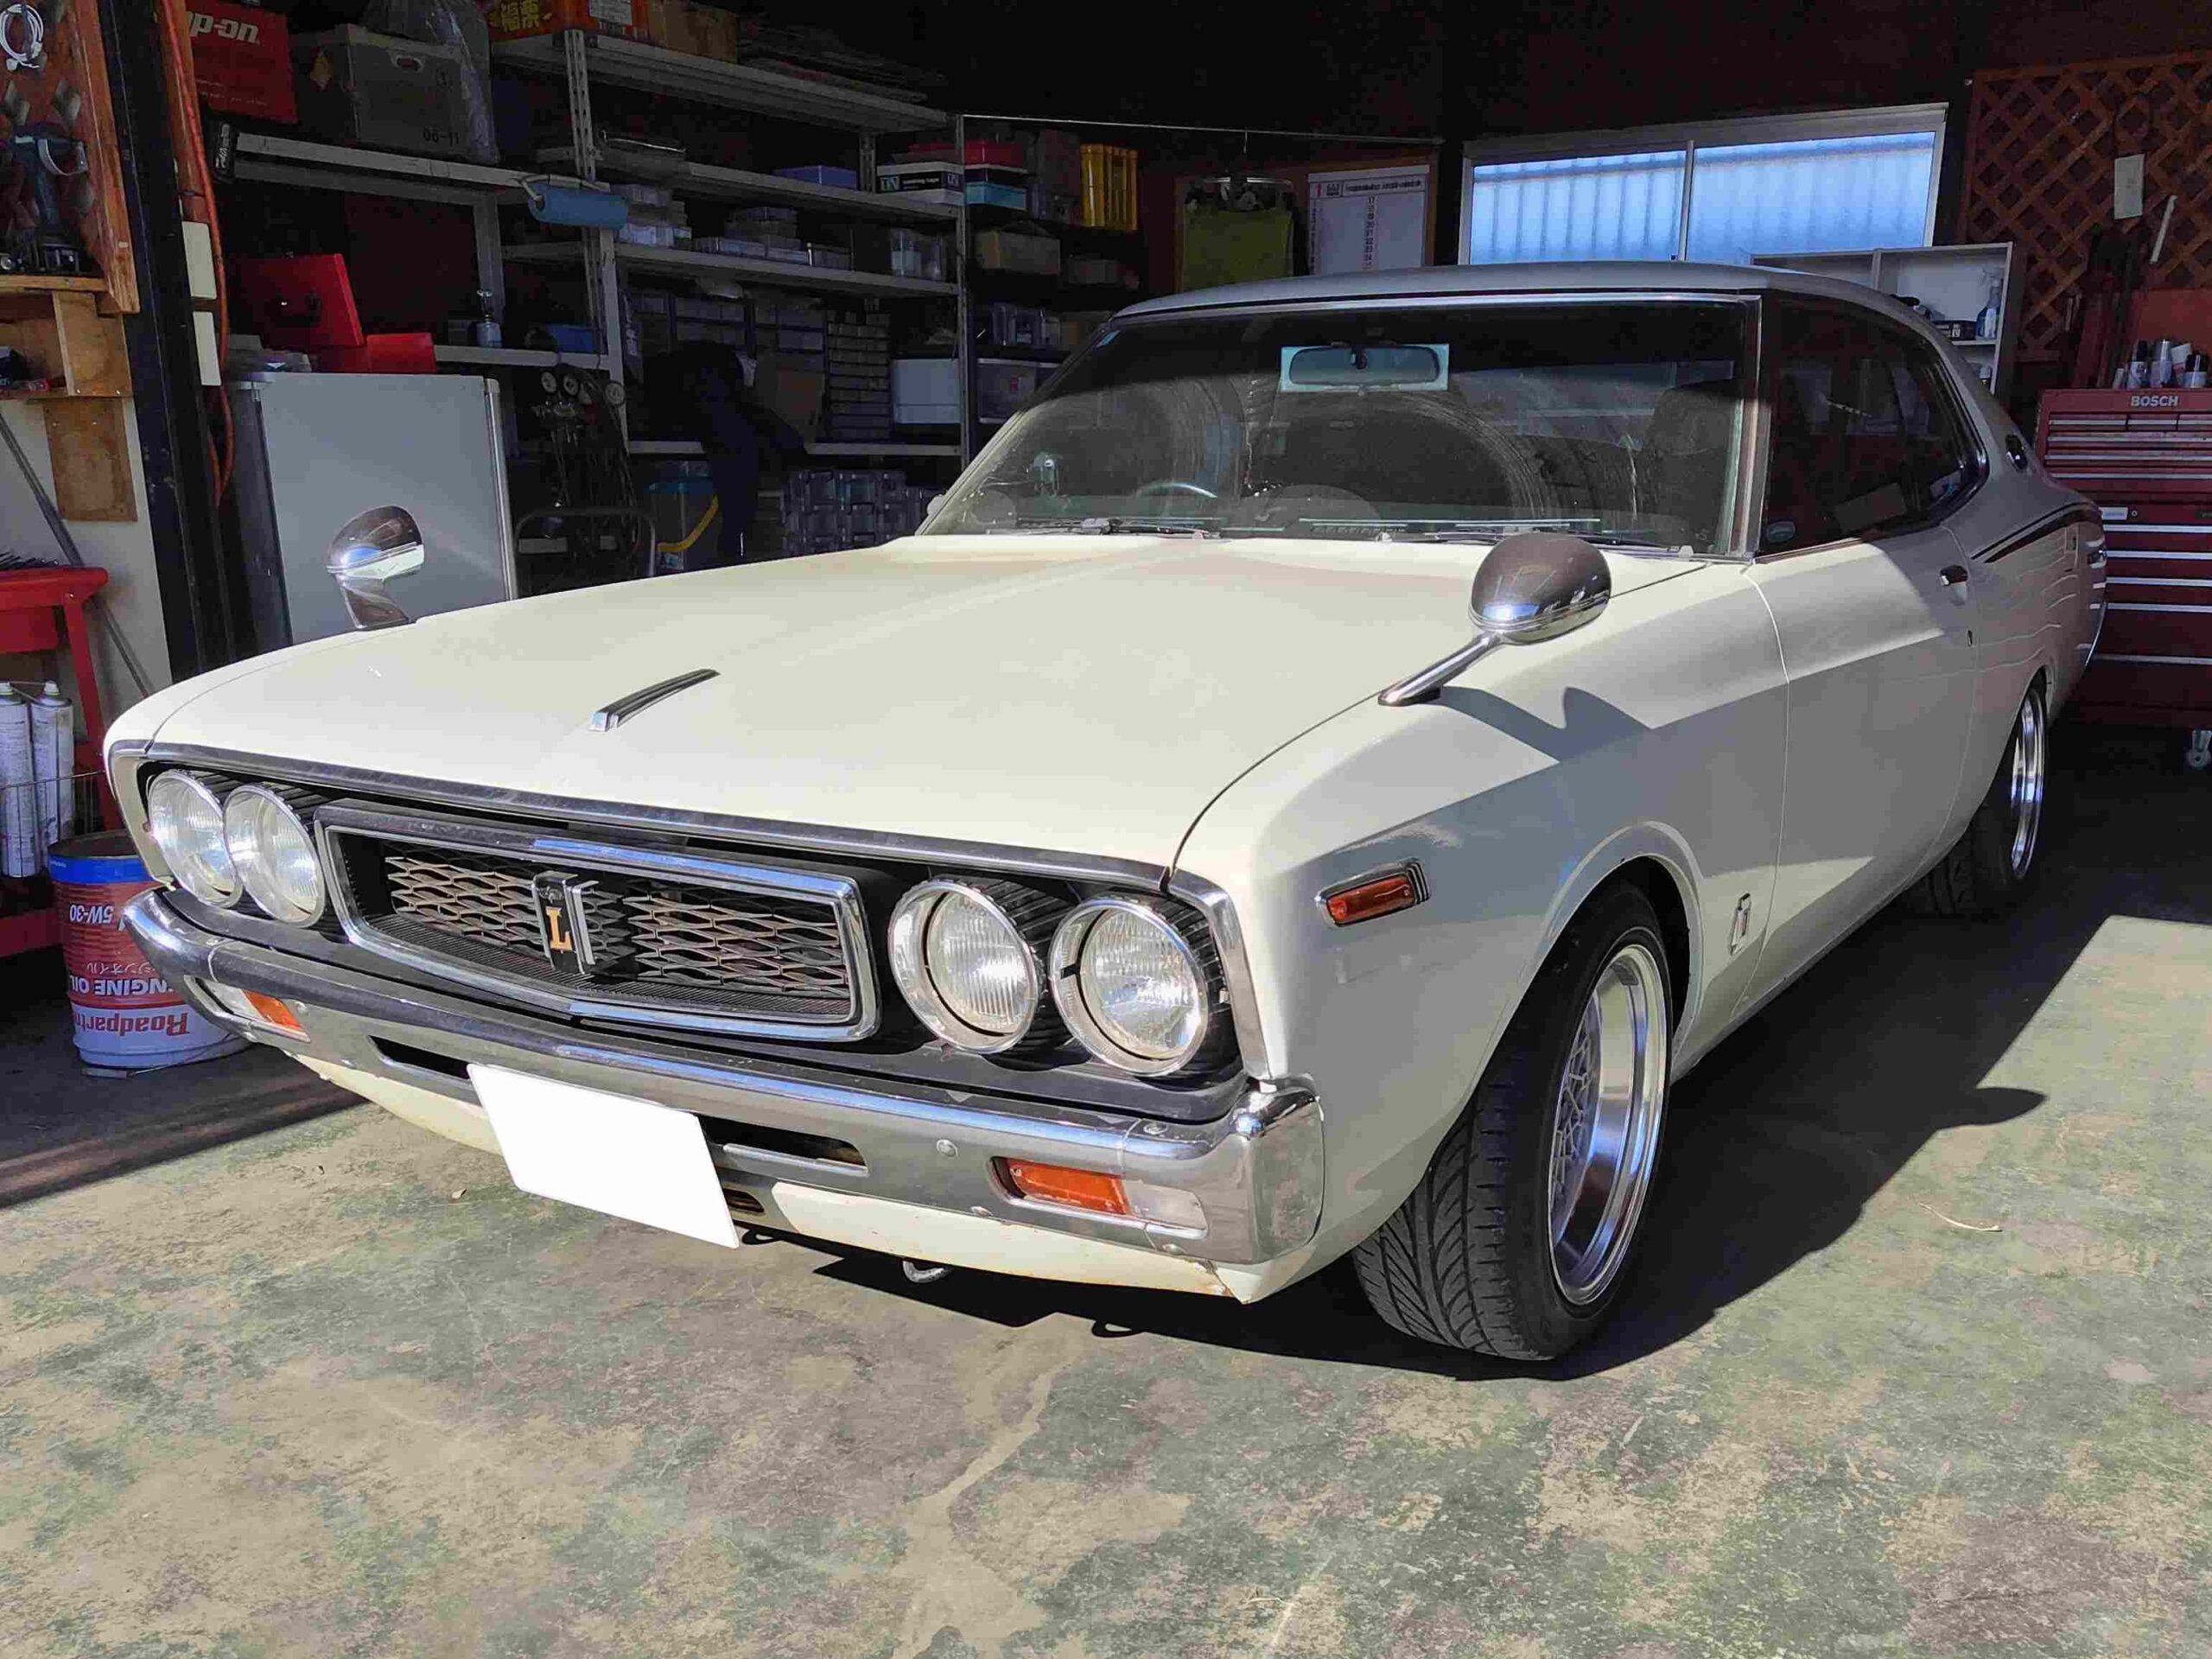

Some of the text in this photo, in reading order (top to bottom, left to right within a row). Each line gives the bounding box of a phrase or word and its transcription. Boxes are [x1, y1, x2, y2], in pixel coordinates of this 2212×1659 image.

[2131, 395, 2178, 407] BOSCH
[69, 903, 114, 924] 5W-30
[545, 906, 573, 952] L
[69, 975, 173, 996] NGINE OIL
